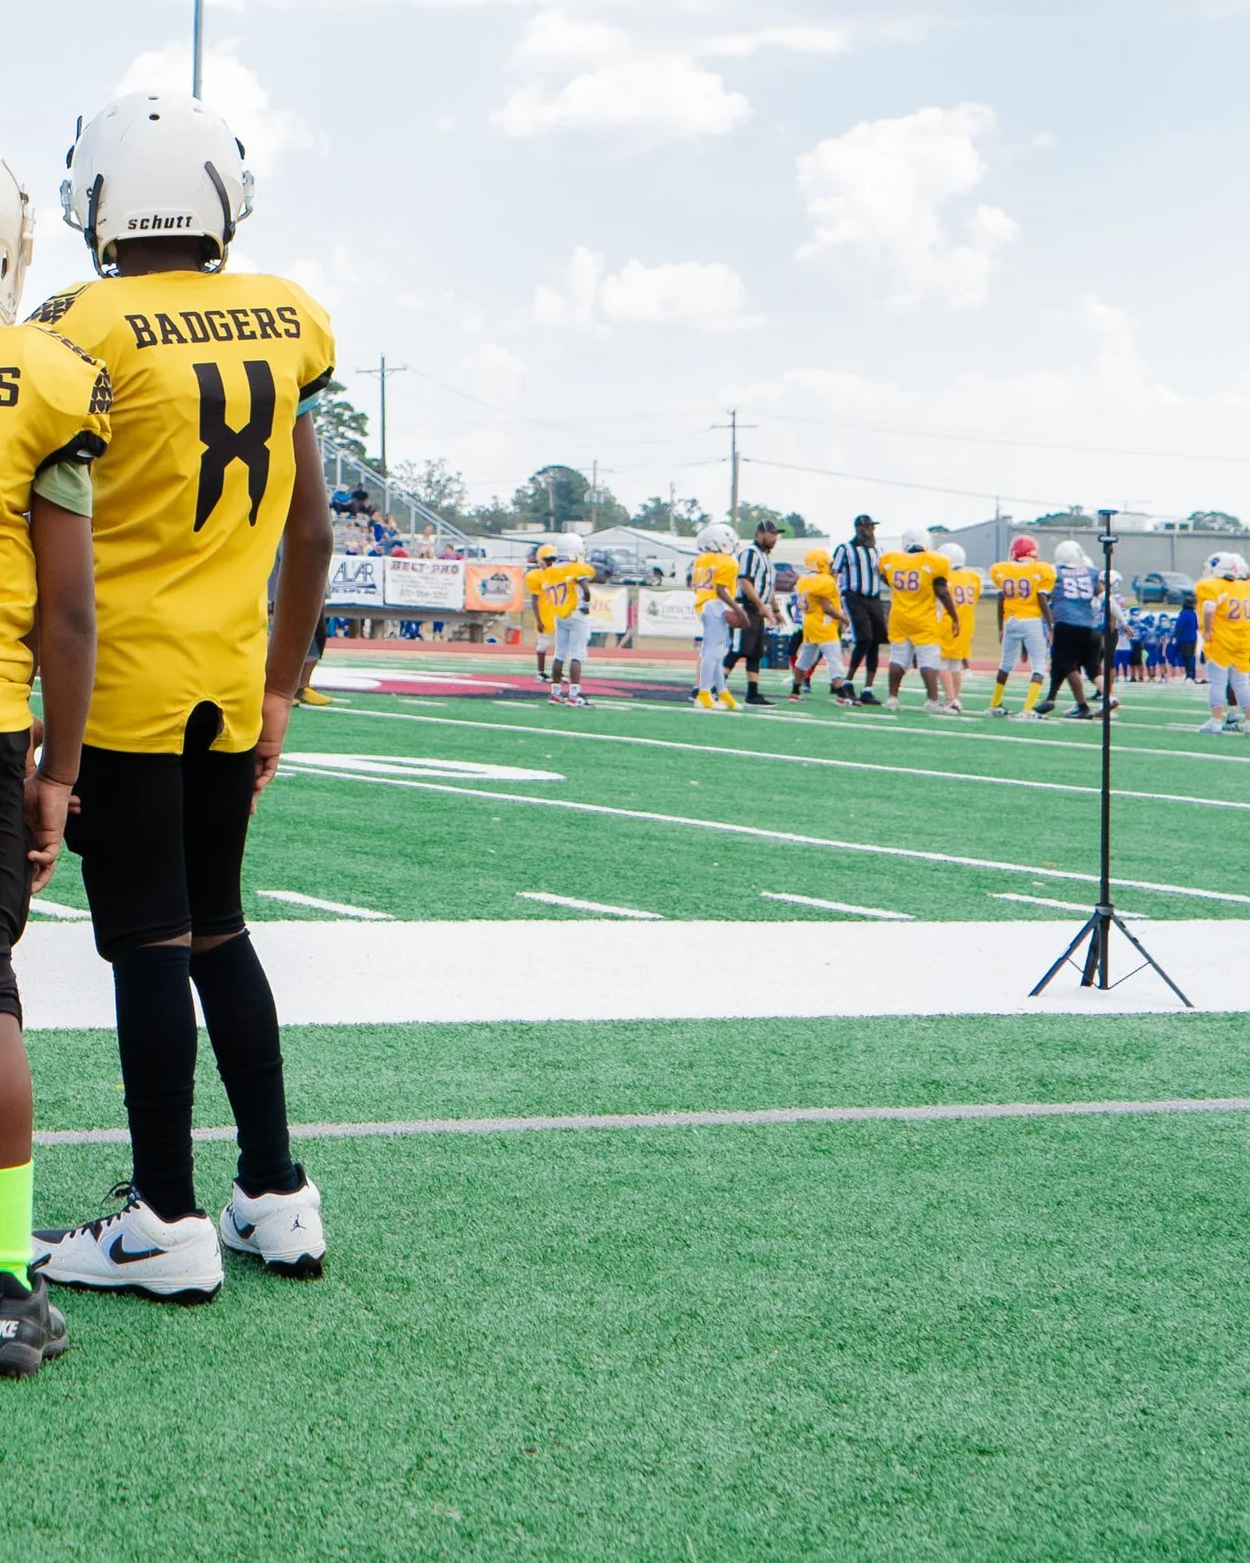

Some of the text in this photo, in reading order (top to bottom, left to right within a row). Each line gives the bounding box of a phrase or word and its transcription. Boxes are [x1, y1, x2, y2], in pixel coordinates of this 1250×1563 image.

[127, 214, 193, 230] schutt
[124, 306, 301, 350] BADGERS
[893, 570, 920, 592] 58
[1002, 578, 1030, 599] 09
[953, 585, 975, 605] 99
